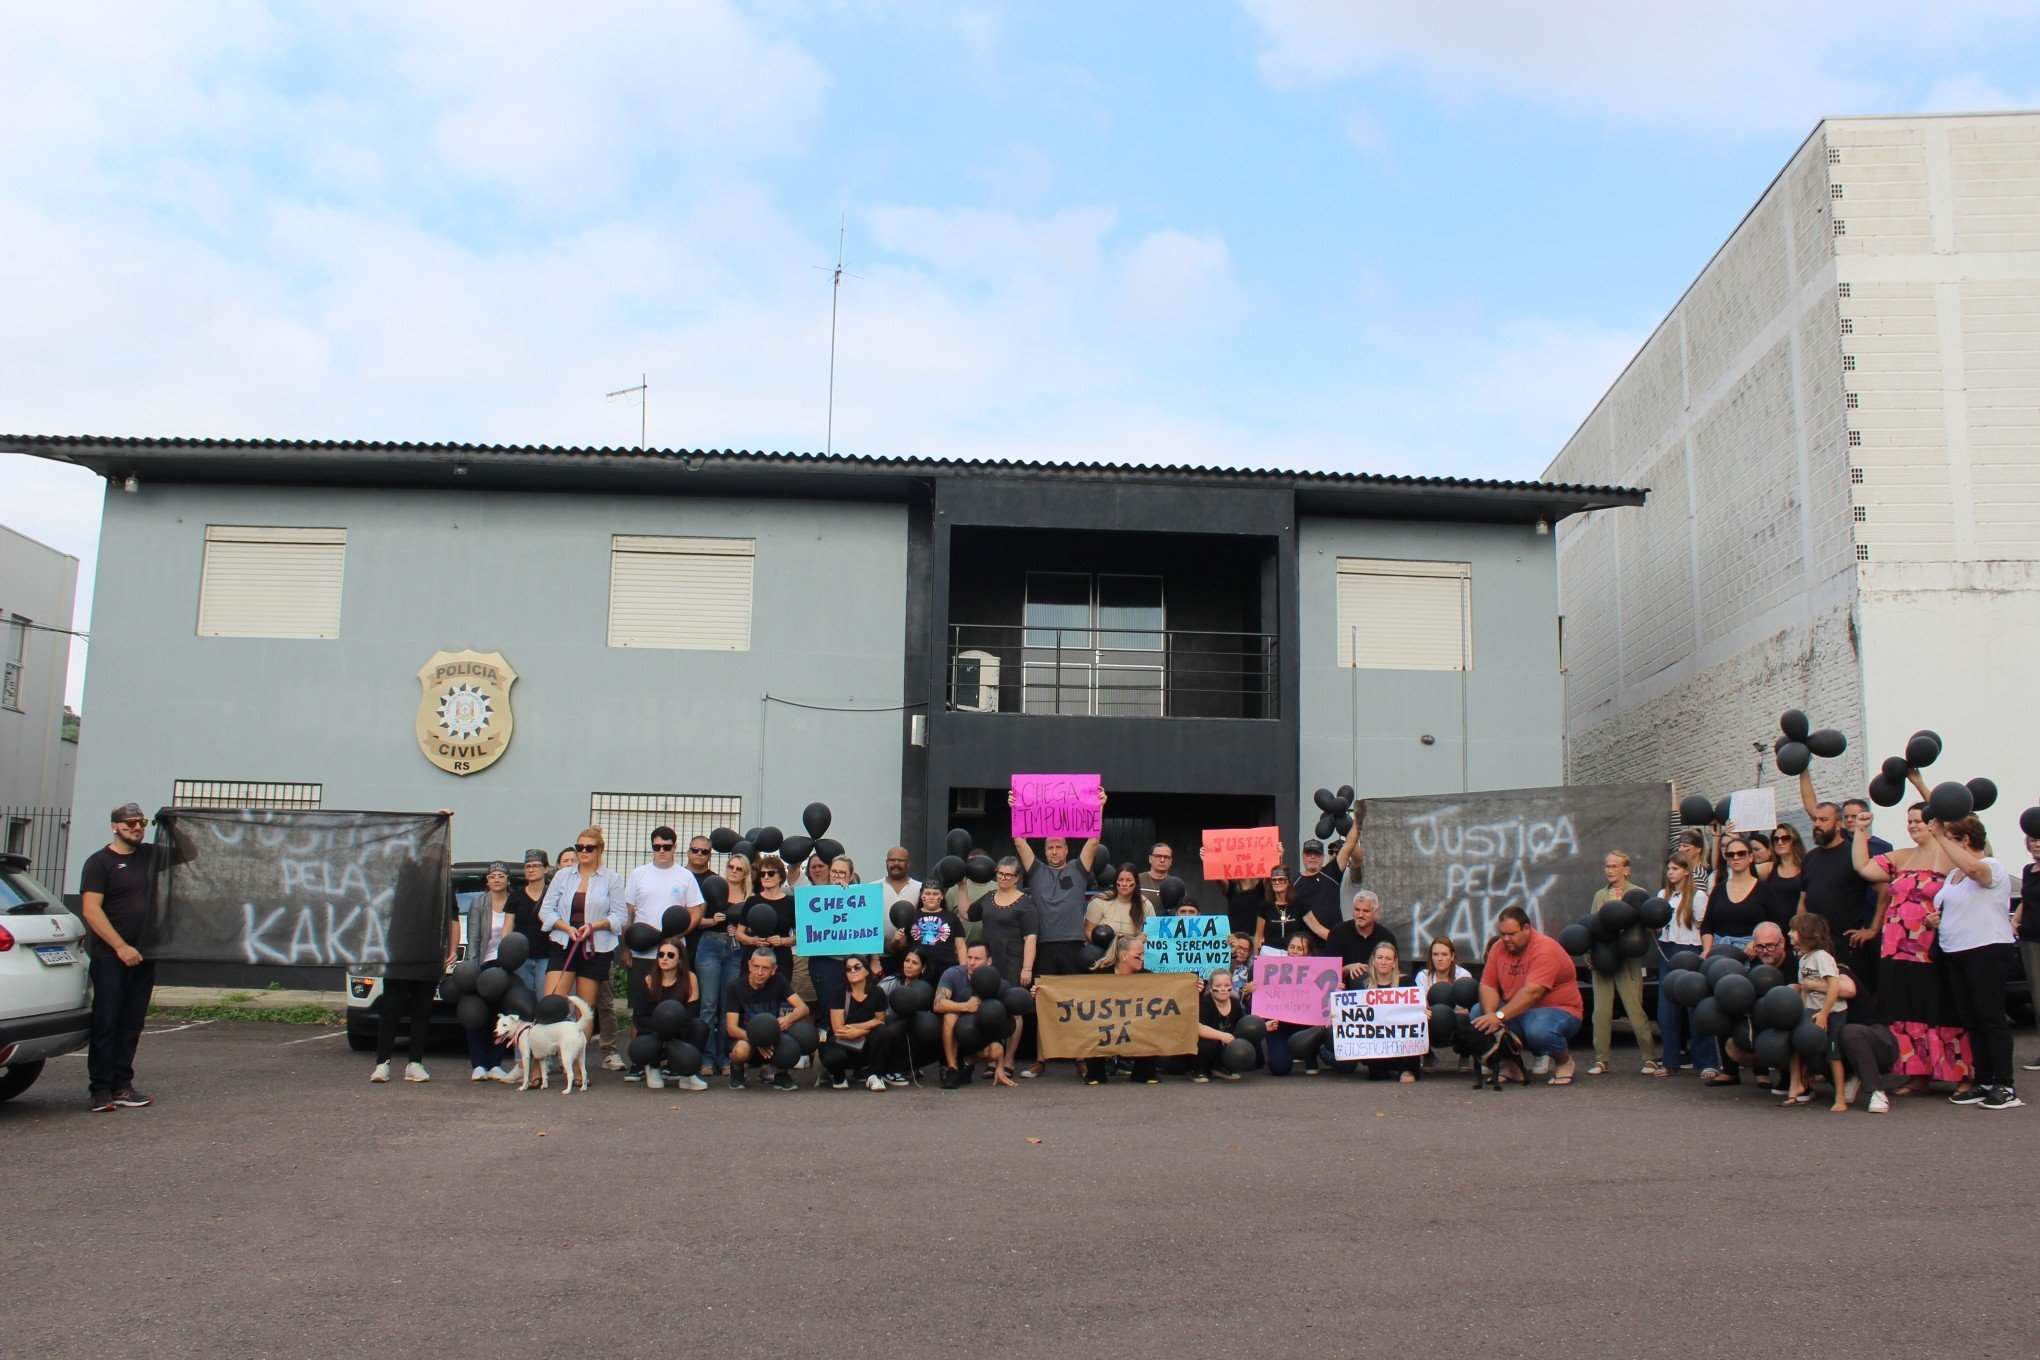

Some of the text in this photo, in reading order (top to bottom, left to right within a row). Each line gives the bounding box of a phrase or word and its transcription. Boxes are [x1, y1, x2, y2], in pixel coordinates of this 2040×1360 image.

[436, 662, 498, 680] POLÍCIA
[438, 743, 488, 758] CIVIL
[454, 761, 470, 771] RS
[1021, 781, 1080, 807] CHEGA
[1236, 853, 1253, 863] POR
[1222, 857, 1267, 879] KAKÁ
[281, 858, 371, 901] PELA
[1446, 858, 1532, 900] PELA
[808, 895, 867, 913] CHEGA
[242, 886, 396, 965] KAKÁ
[832, 912, 848, 924] DE
[1158, 915, 1219, 939] KAKÁ
[1175, 939, 1229, 952] SEREMOS
[1159, 951, 1230, 964] A TUA VOZ
[1263, 963, 1311, 986] PRF
[1334, 988, 1420, 1006] FOI CRIME
[1098, 1020, 1132, 1047] JÁ
[1336, 1021, 1425, 1038] ACIDENTE!
